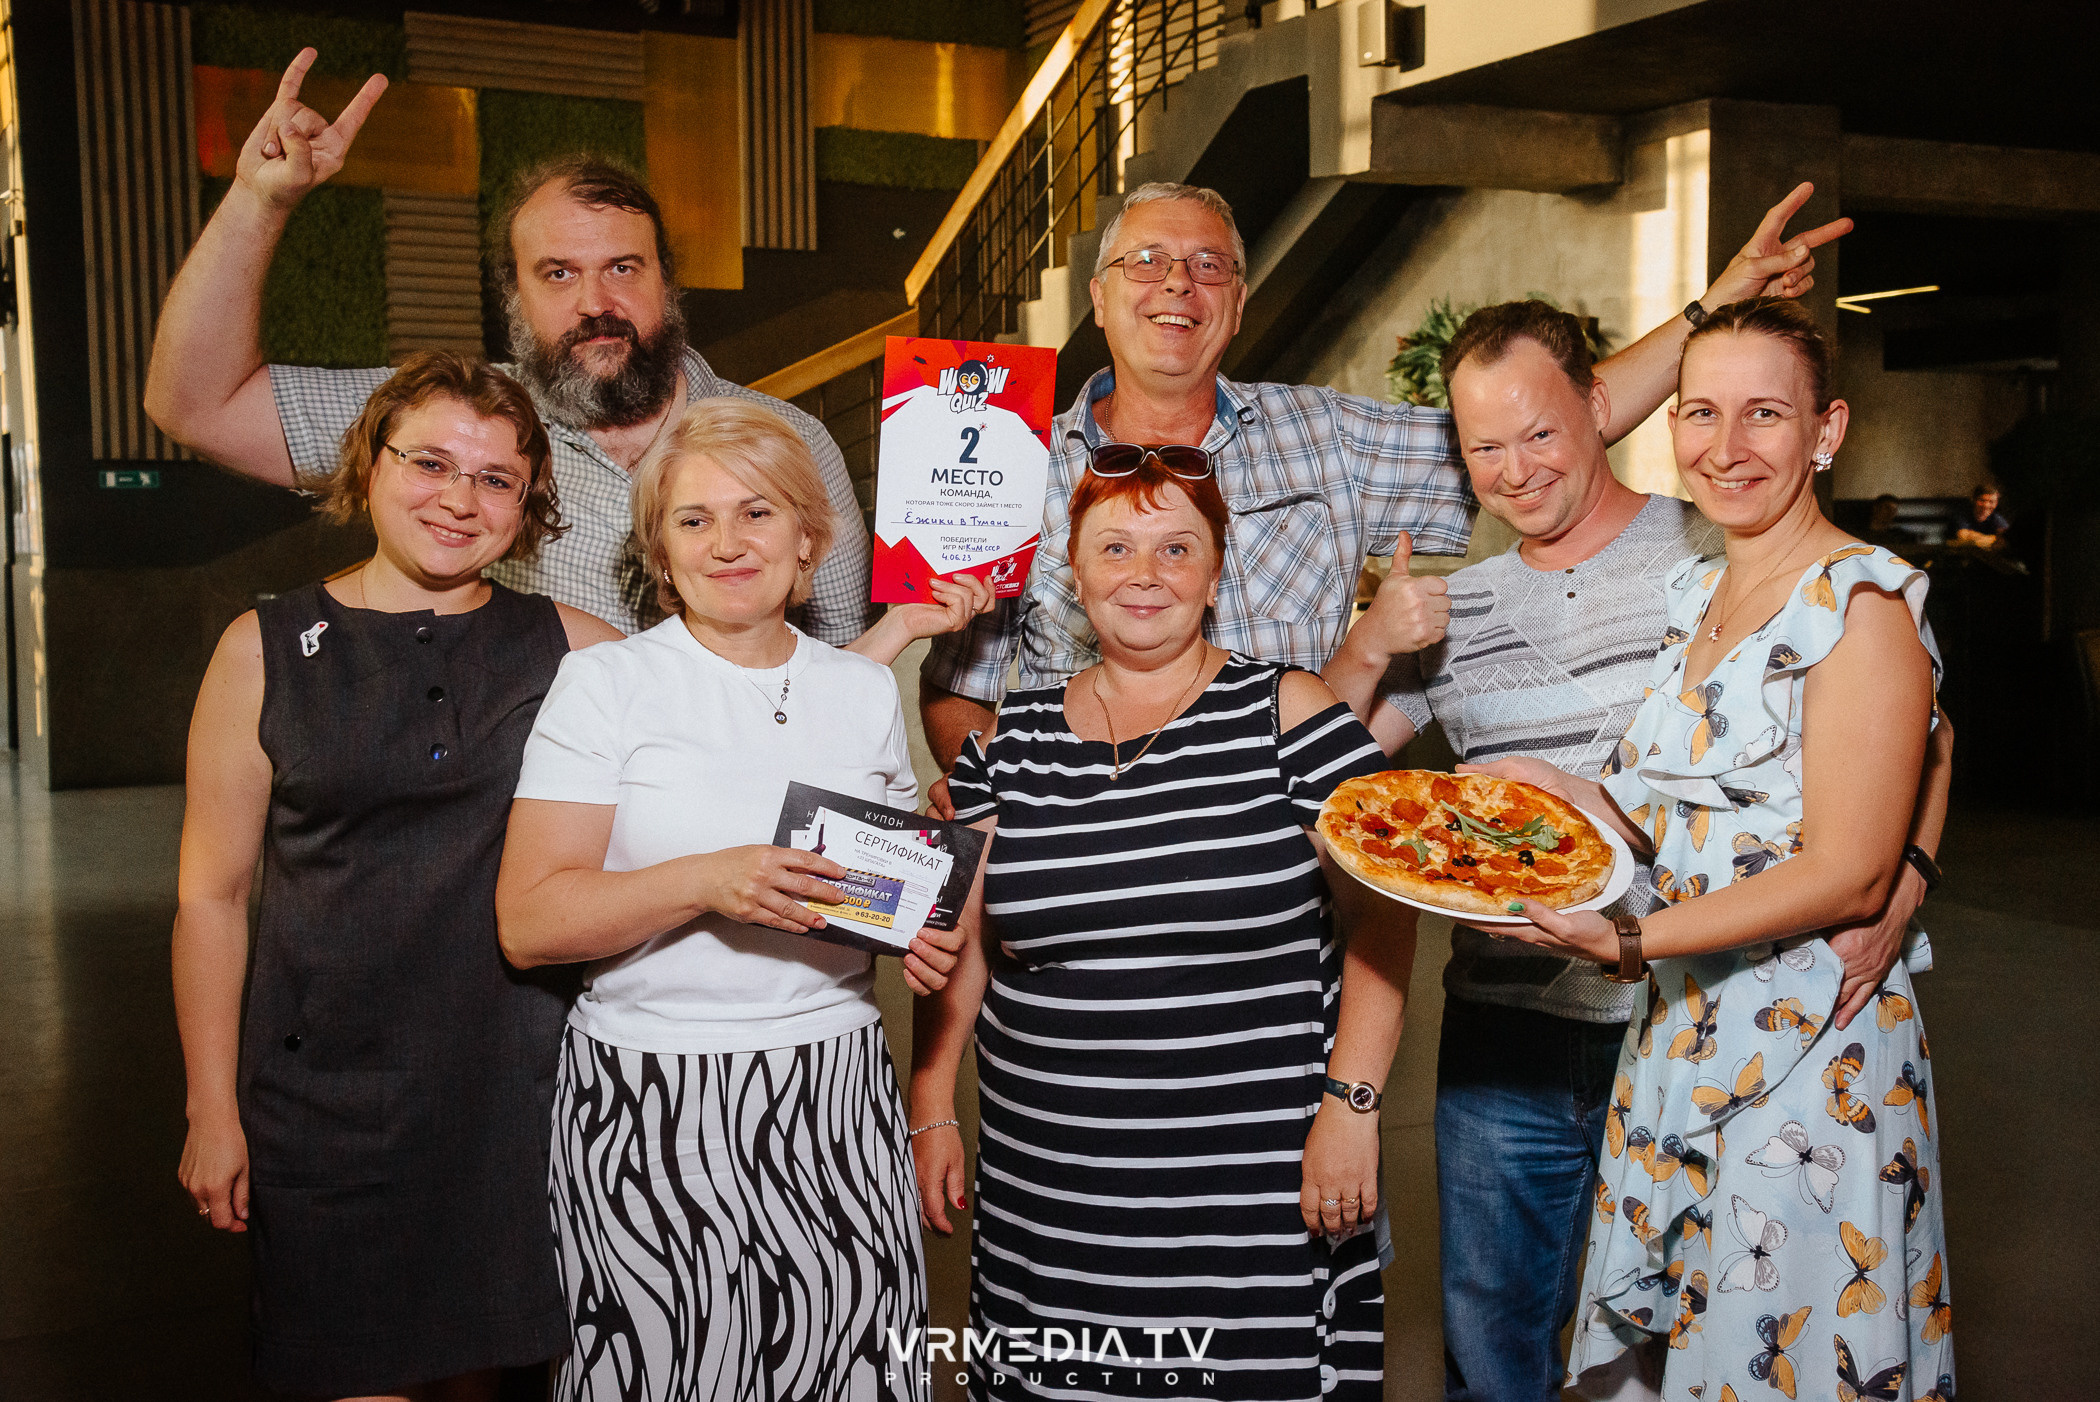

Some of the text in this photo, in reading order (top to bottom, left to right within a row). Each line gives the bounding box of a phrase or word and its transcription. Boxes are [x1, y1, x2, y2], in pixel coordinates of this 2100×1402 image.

[937, 361, 1010, 396] WOW
[950, 391, 989, 414] QUIZ
[959, 427, 980, 464] 2
[930, 468, 1004, 486] МЕСТО
[940, 536, 987, 544] ПОБЕДИТЕЛИ
[864, 811, 904, 828] КУПОН
[855, 831, 943, 871] СЕРТИФИКАТ
[860, 911, 891, 923] 63-20-20
